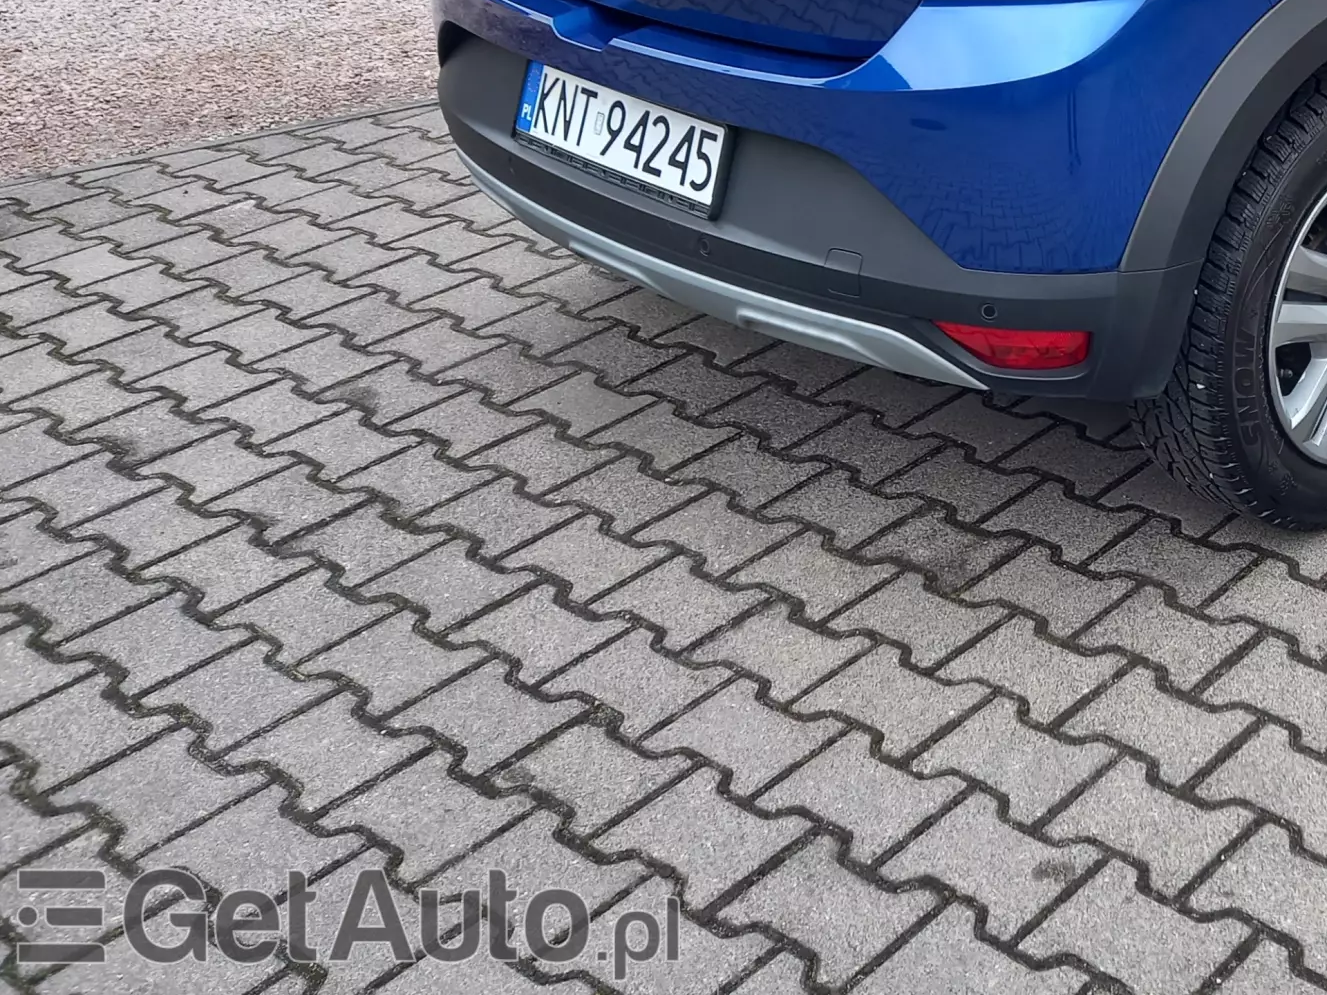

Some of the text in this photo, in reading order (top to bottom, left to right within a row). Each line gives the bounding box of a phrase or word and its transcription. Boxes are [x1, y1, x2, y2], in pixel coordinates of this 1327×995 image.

[521, 103, 532, 121] PL
[533, 72, 719, 192] KNT 94245
